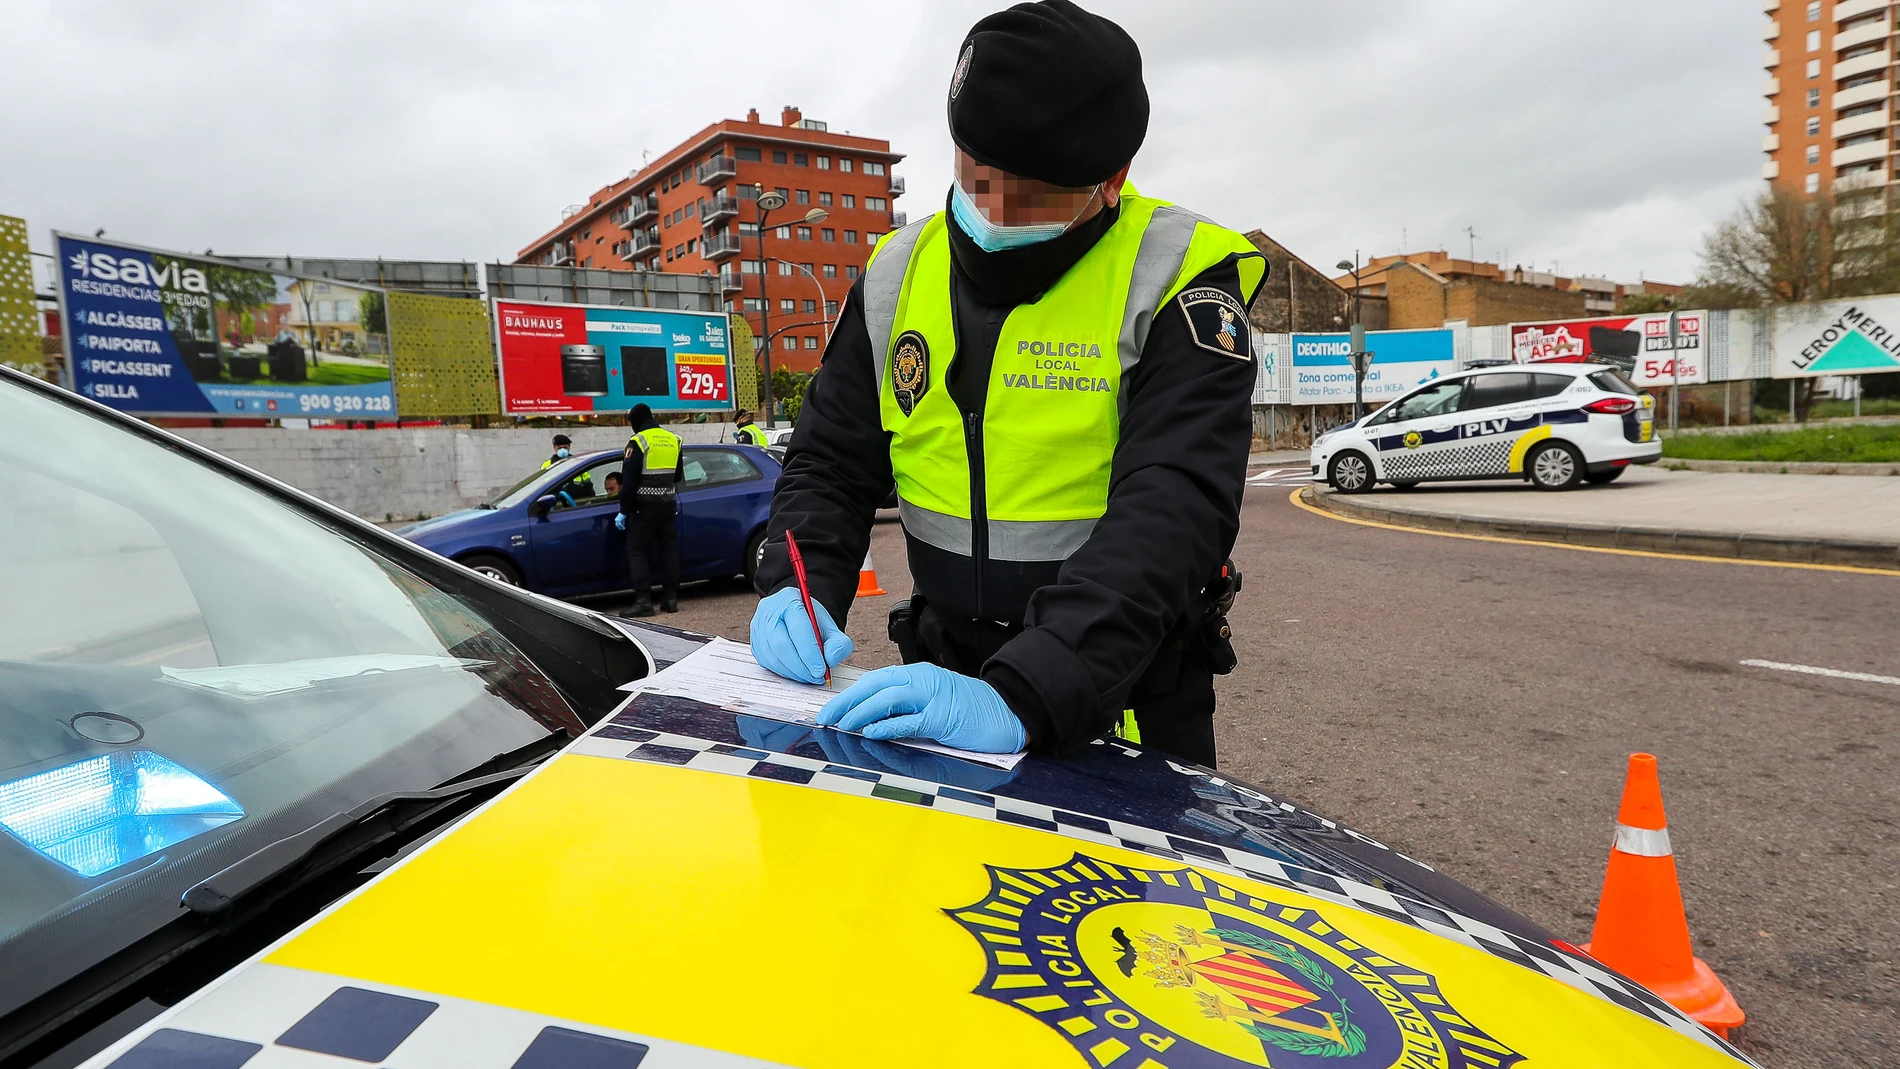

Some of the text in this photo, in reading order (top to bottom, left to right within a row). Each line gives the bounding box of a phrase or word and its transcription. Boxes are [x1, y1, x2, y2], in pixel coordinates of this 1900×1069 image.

[90, 253, 210, 294] savia
[71, 279, 162, 302] RESIDENCIAS
[1188, 291, 1225, 301] POLICIA
[87, 310, 163, 331] ALCÀSSER
[505, 316, 563, 330] BAUHAUS
[611, 323, 625, 331] Pack
[705, 321, 711, 336] 5
[88, 335, 162, 354] PAIPORTA
[672, 333, 691, 342] beko
[1792, 306, 1900, 369] LEROY MERLI
[678, 354, 691, 362] GRAN
[1018, 341, 1101, 358] POLICIA
[91, 359, 172, 377] PICASSENT
[1036, 360, 1080, 371] LOCAL
[1679, 366, 1697, 377] 95
[1003, 372, 1110, 392] VALÈNCIA
[1298, 373, 1321, 383] Zona
[95, 383, 139, 398] SILLA
[1323, 387, 1341, 395] Parc
[1384, 383, 1405, 392] IKEA
[300, 393, 391, 412] 900 920 228
[1465, 418, 1508, 437] PLV
[1040, 885, 1141, 924] LOCAL
[1037, 935, 1176, 1055] POLICIA
